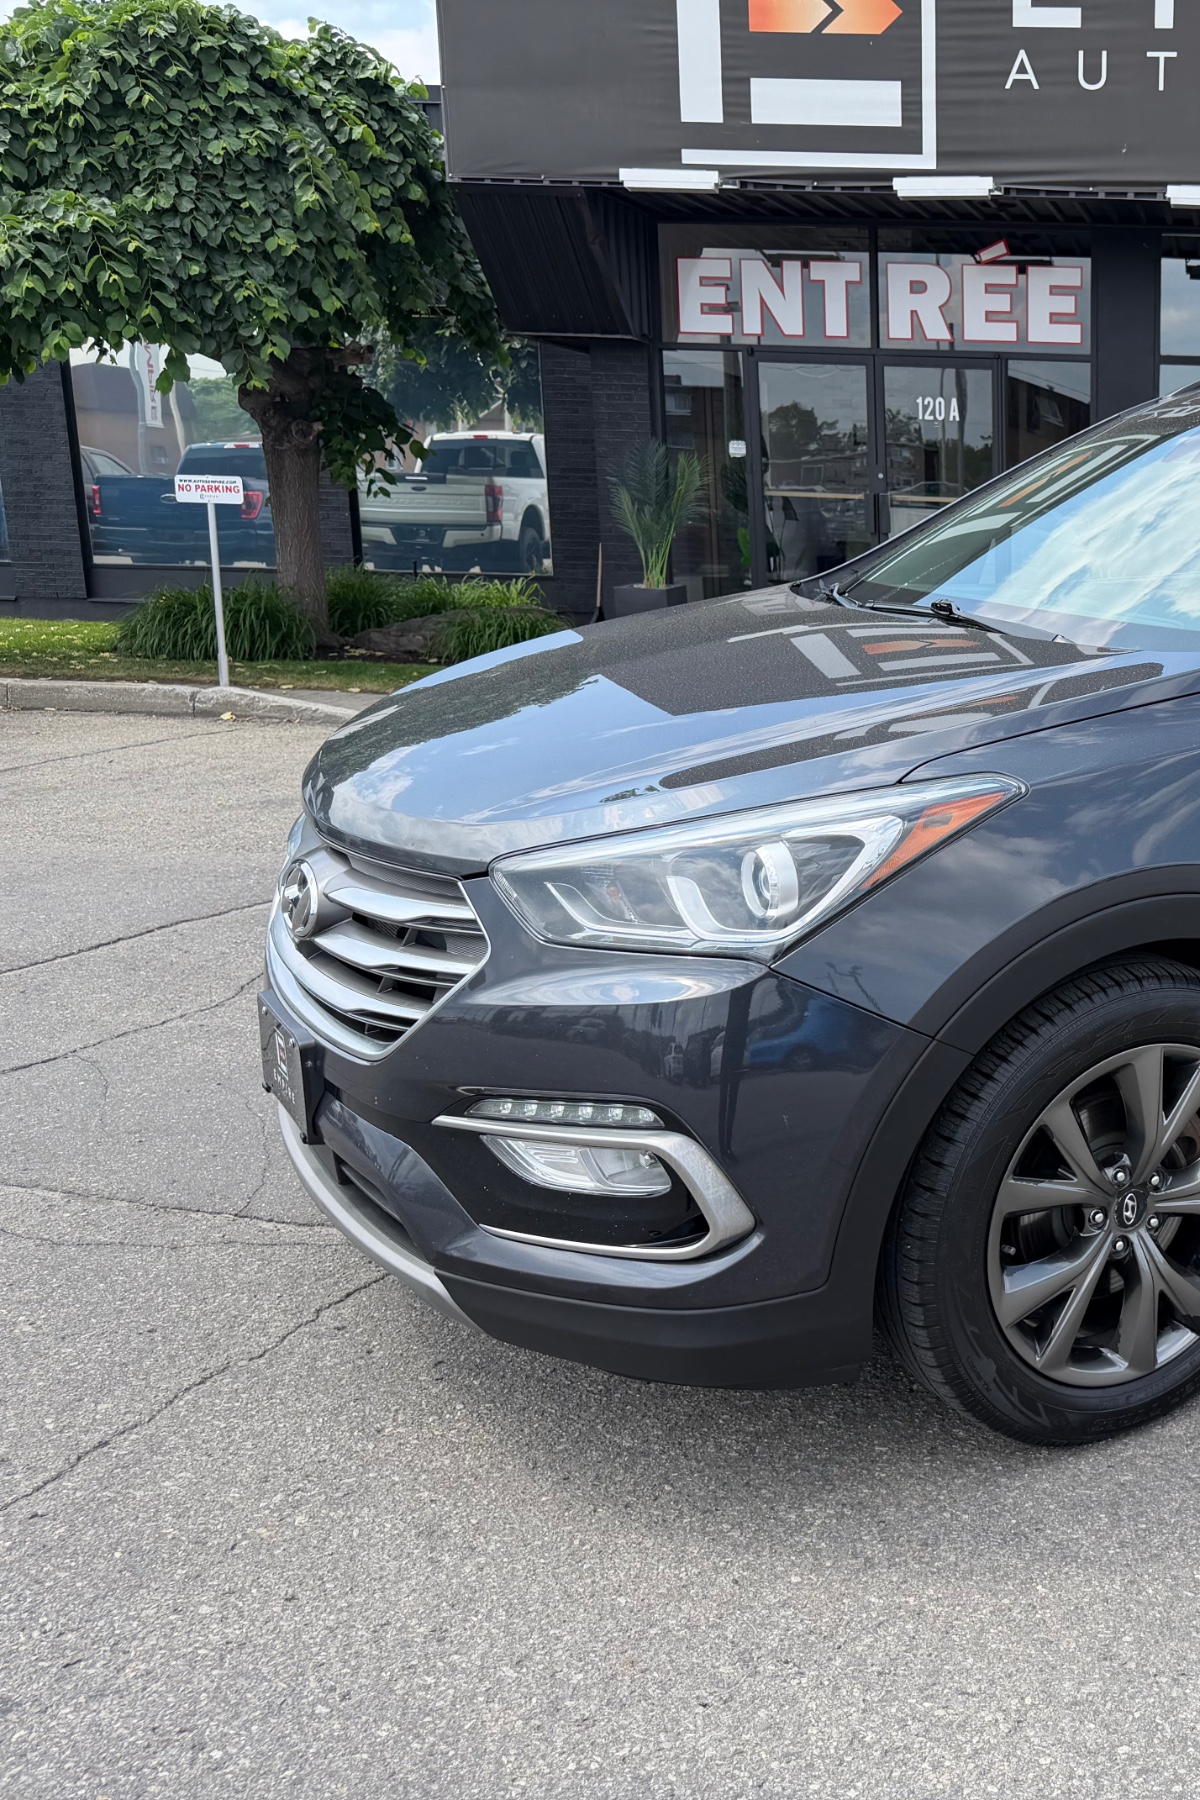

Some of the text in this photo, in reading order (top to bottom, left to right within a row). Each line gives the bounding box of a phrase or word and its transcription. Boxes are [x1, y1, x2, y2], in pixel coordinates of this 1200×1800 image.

[676, 238, 1084, 344] ENTRÉE
[916, 397, 960, 421] 120 A
[177, 484, 240, 494] NO PARKING
